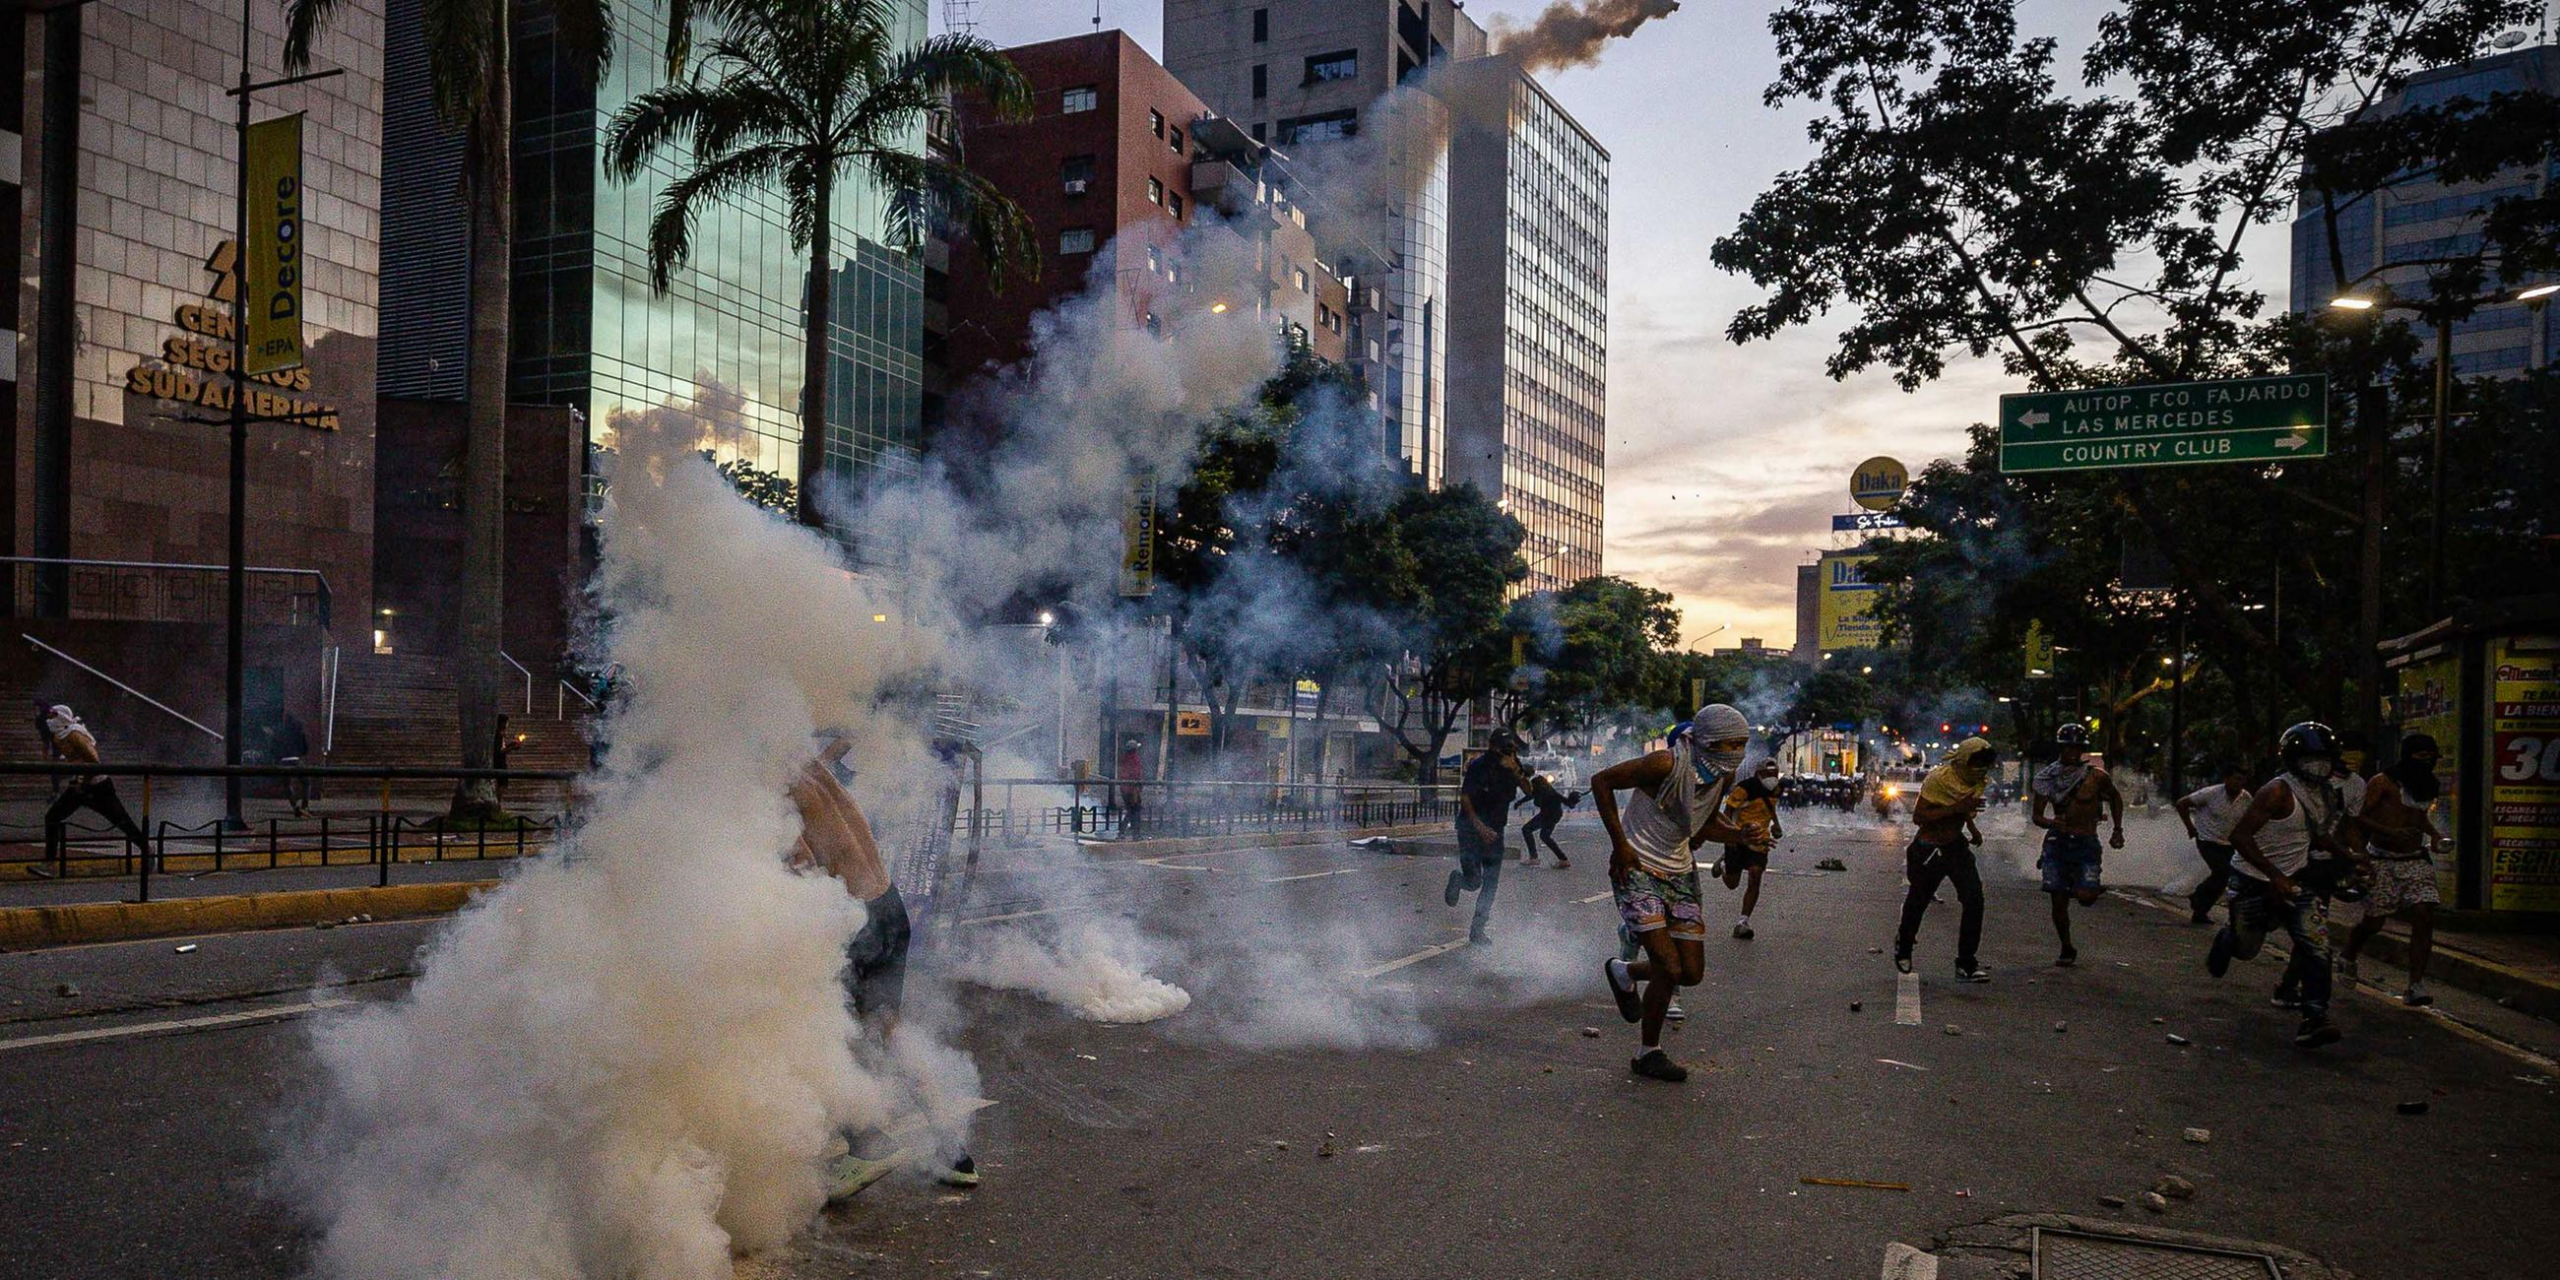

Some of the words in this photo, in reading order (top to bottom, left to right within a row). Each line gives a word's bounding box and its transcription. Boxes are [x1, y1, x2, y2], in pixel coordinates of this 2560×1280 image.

[271, 176, 295, 321] Decore
[266, 337, 294, 356] EPA
[2063, 394, 2139, 415] AUTOP.
[2149, 391, 2196, 408] FCO.
[2207, 383, 2311, 404] FAJARDO
[2062, 416, 2104, 435] LAS
[2115, 409, 2234, 430] MERCEDES
[2062, 441, 2162, 463] COUNTRY
[2175, 438, 2231, 456] CLUB
[1859, 471, 1901, 492] Daka
[2504, 705, 2522, 716] LA
